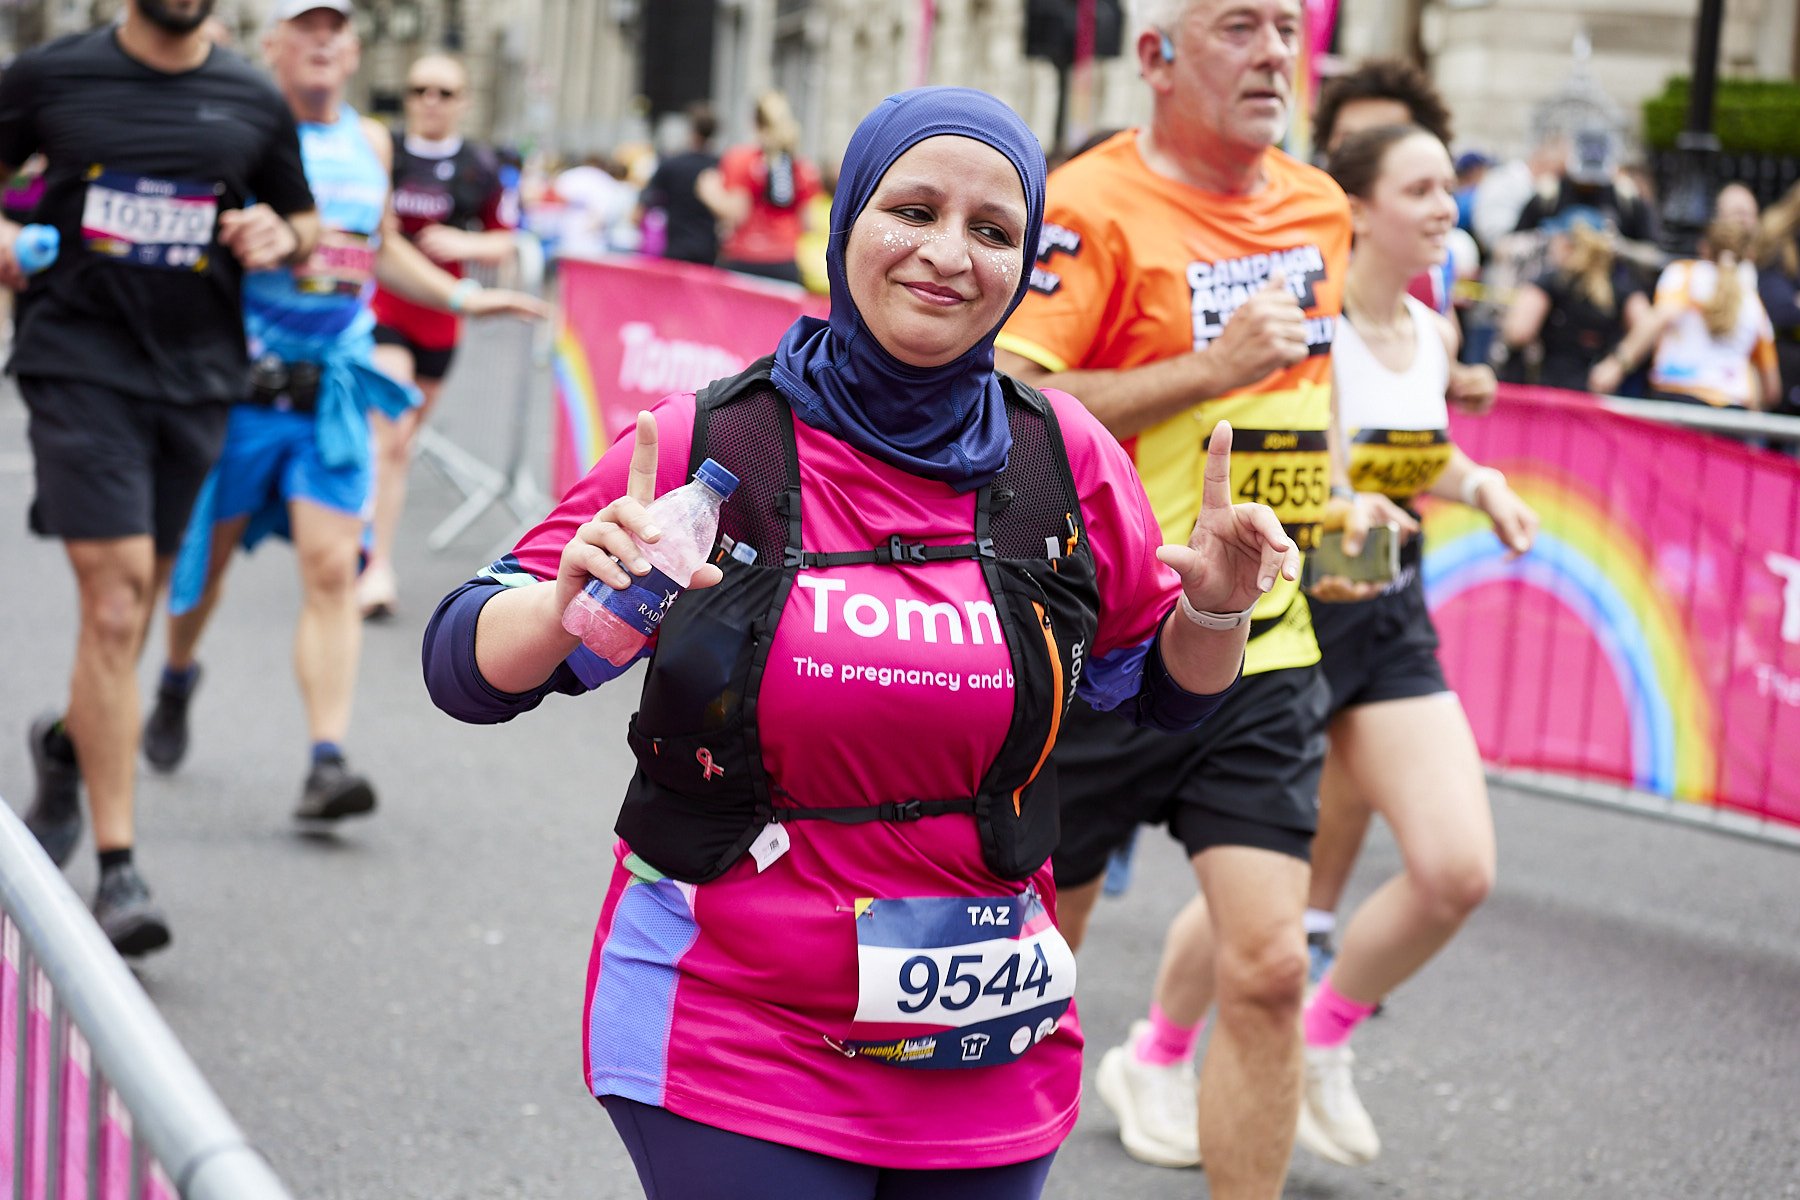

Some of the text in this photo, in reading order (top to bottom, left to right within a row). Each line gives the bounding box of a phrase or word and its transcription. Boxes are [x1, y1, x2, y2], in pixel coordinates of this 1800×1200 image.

[1237, 465, 1326, 507] 4555
[638, 603, 661, 624] RAD
[793, 655, 834, 678] The
[841, 663, 961, 692] pregnancy
[967, 667, 1003, 689] and
[967, 905, 1010, 926] TAZ
[897, 942, 1053, 1014] 9544
